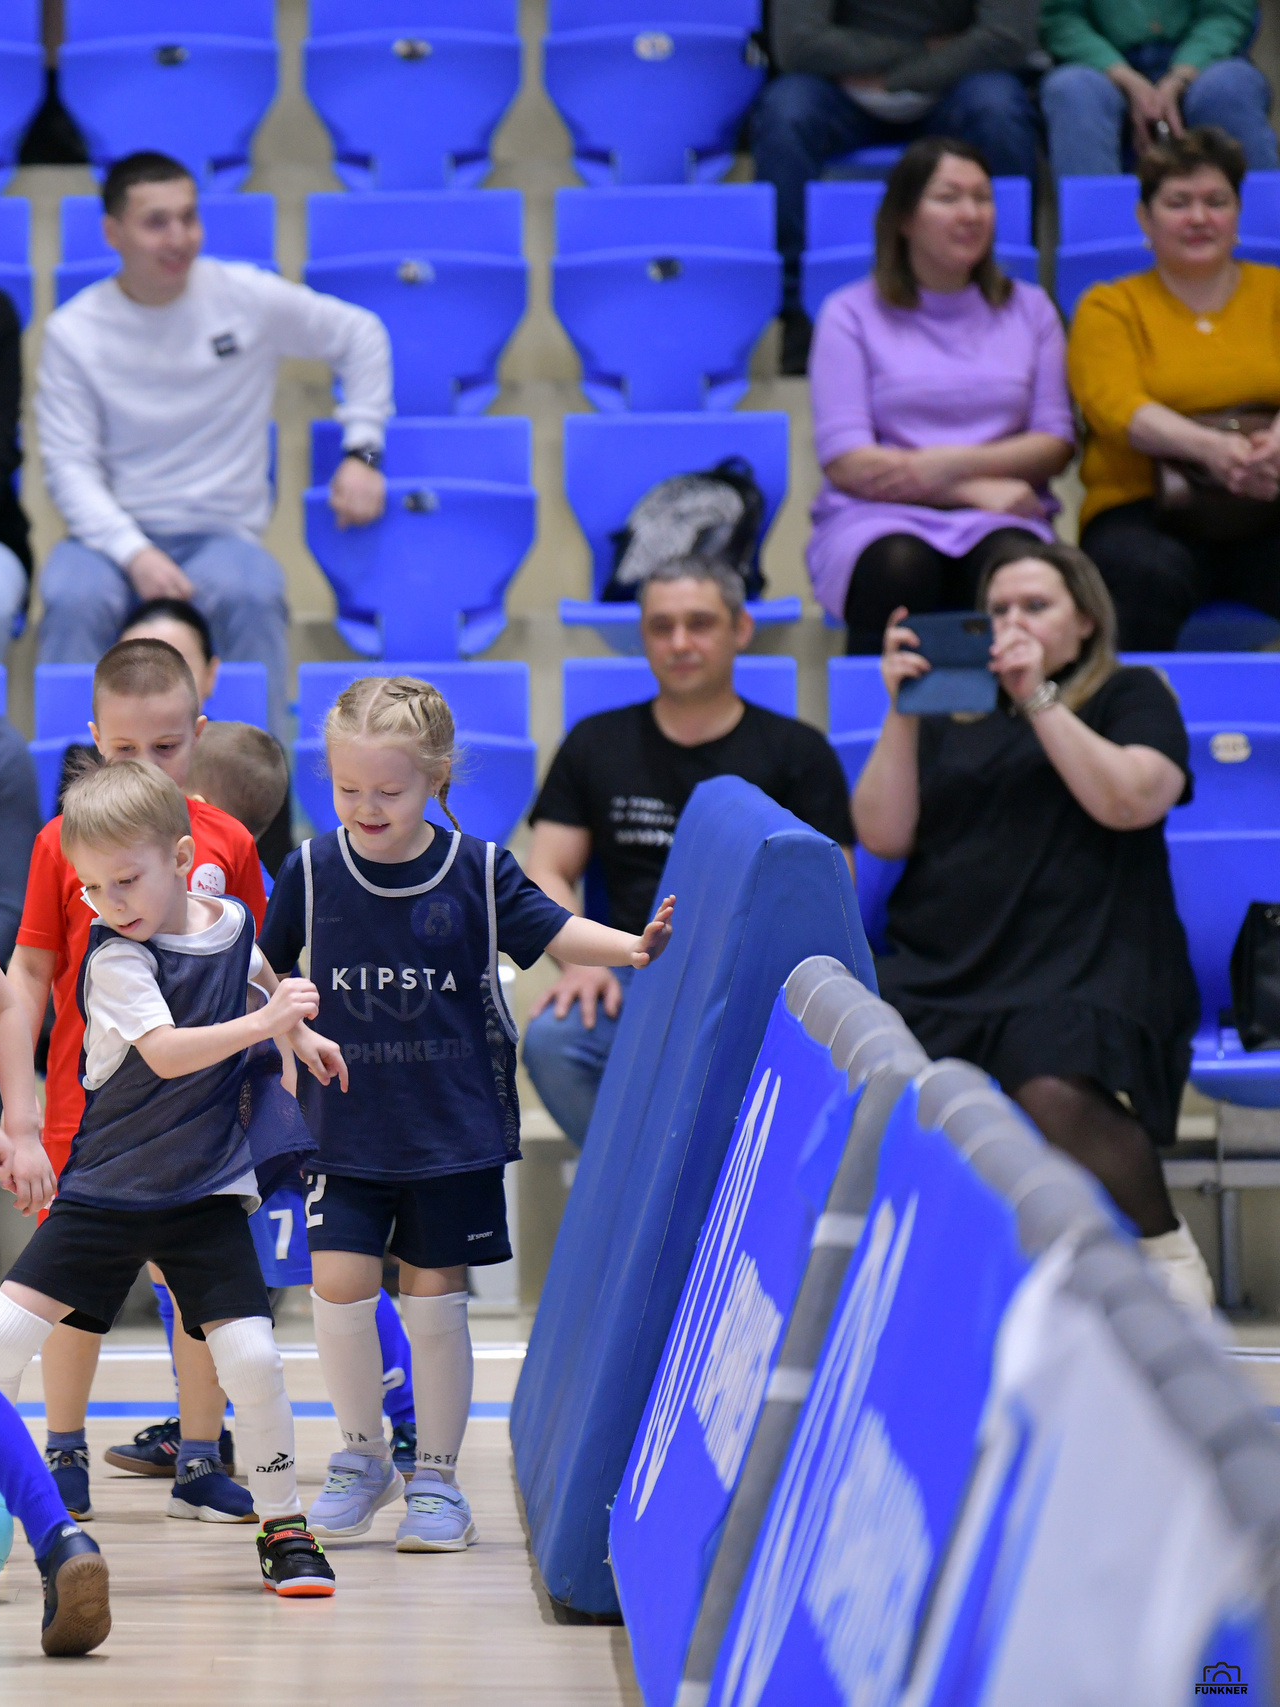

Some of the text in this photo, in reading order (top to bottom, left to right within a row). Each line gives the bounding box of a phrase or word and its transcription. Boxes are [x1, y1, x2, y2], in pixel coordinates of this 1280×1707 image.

[332, 967, 457, 992] KIPSTA
[342, 1039, 475, 1064] РНИКЕЛЬ
[304, 1174, 327, 1229] 2
[268, 1209, 293, 1260] 7
